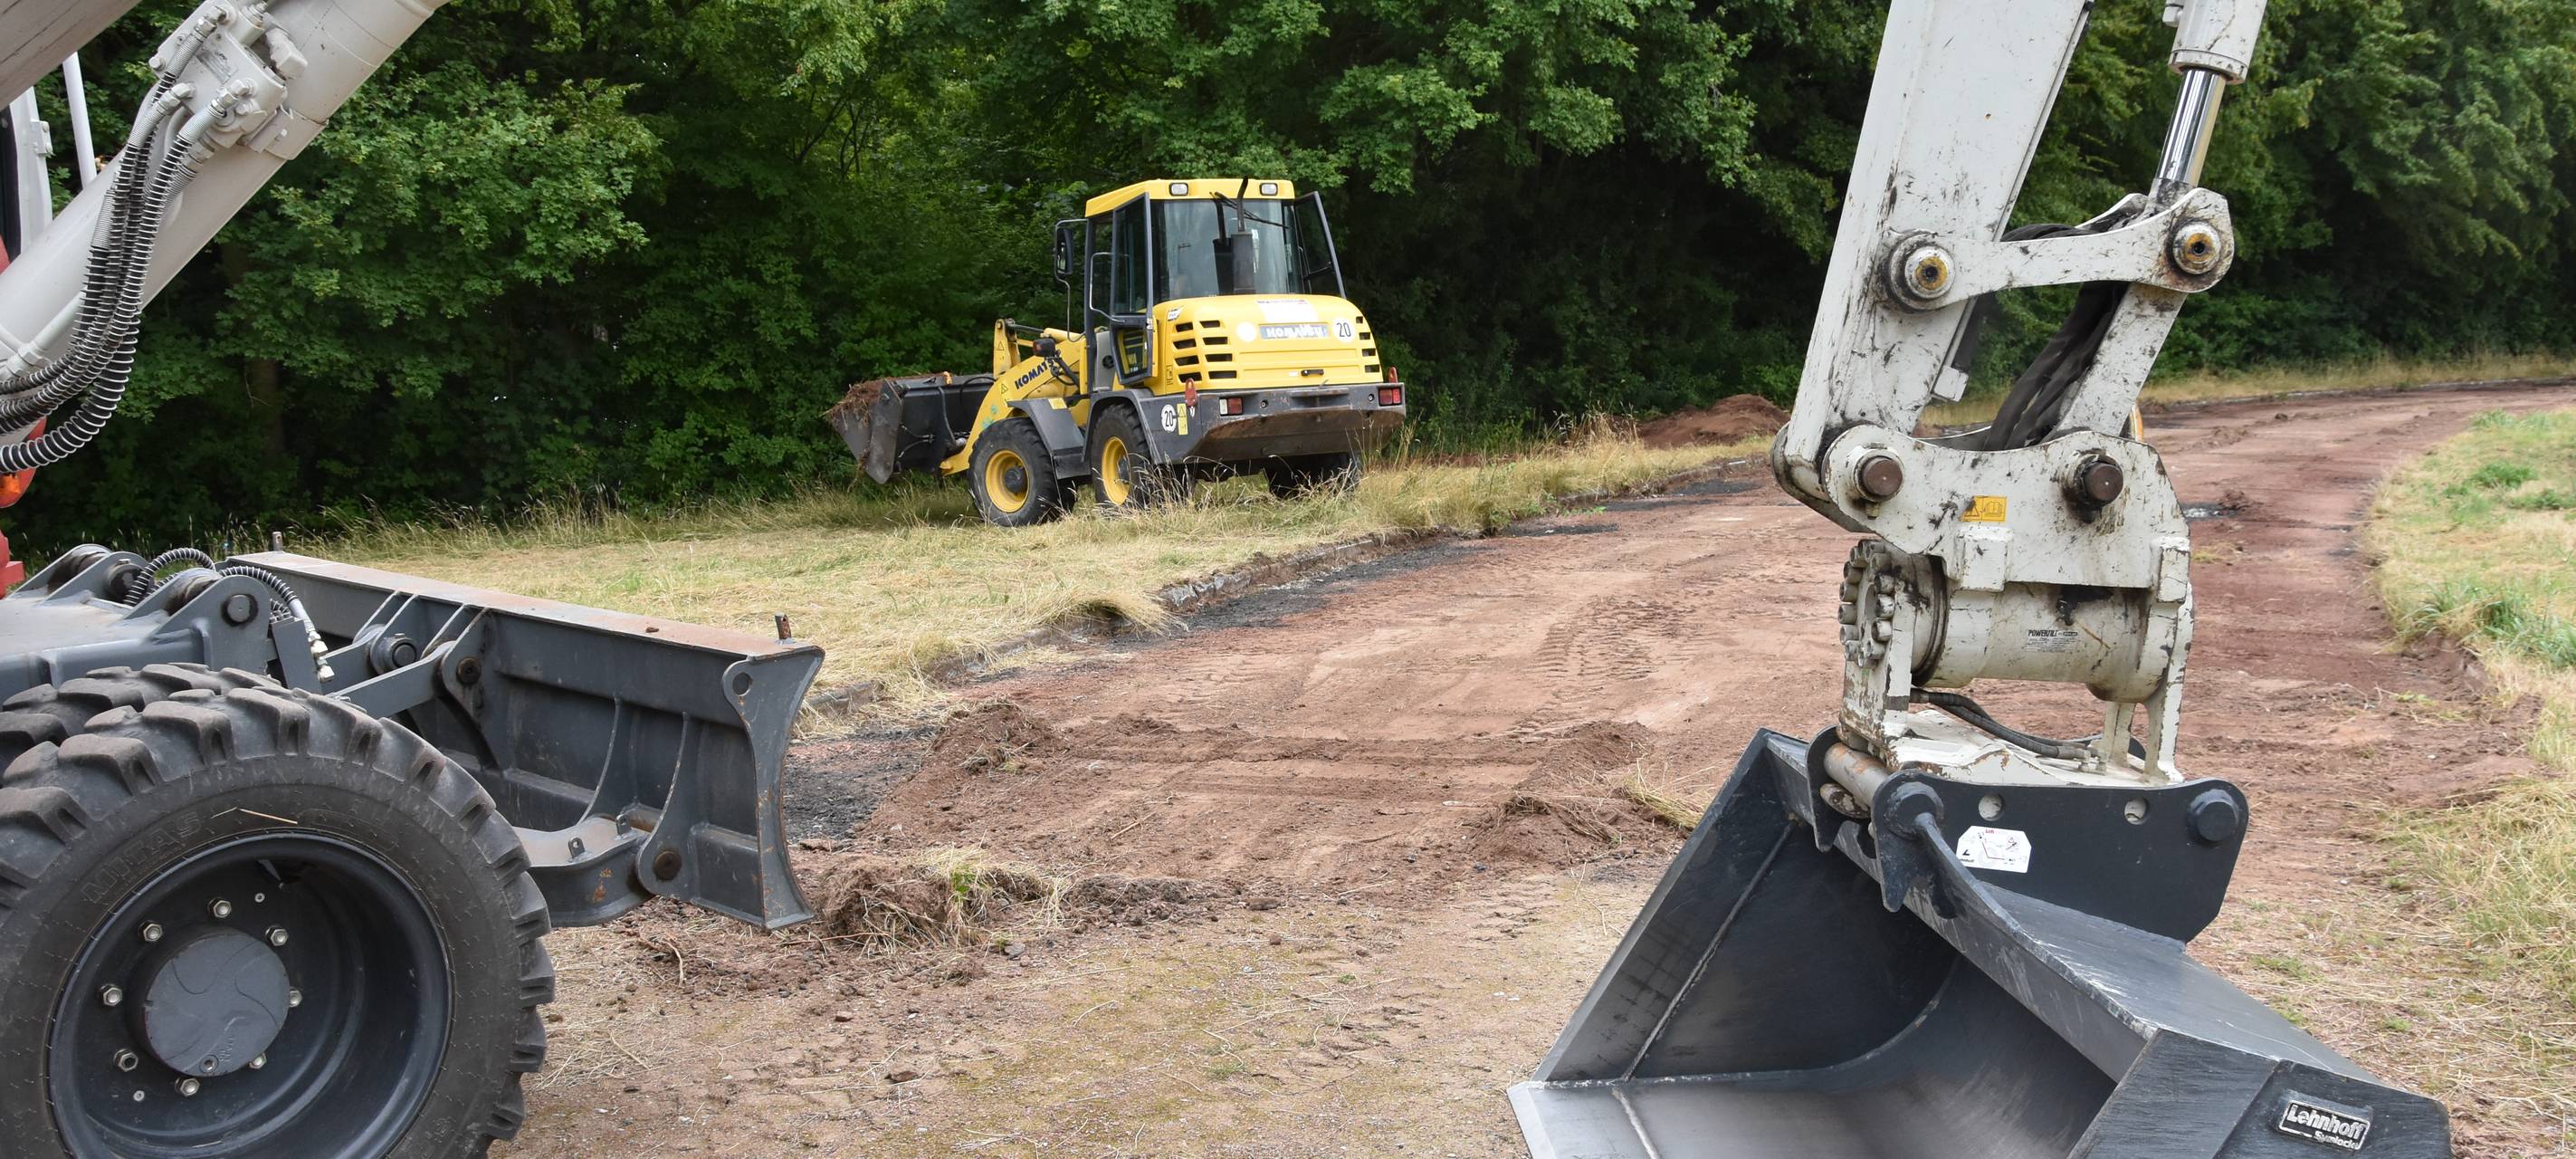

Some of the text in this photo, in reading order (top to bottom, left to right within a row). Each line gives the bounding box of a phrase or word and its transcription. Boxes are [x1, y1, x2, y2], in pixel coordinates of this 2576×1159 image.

[1336, 322, 1351, 338] 20
[1164, 410, 1174, 427] 20
[2286, 1105, 2365, 1139] Lehnhoff
